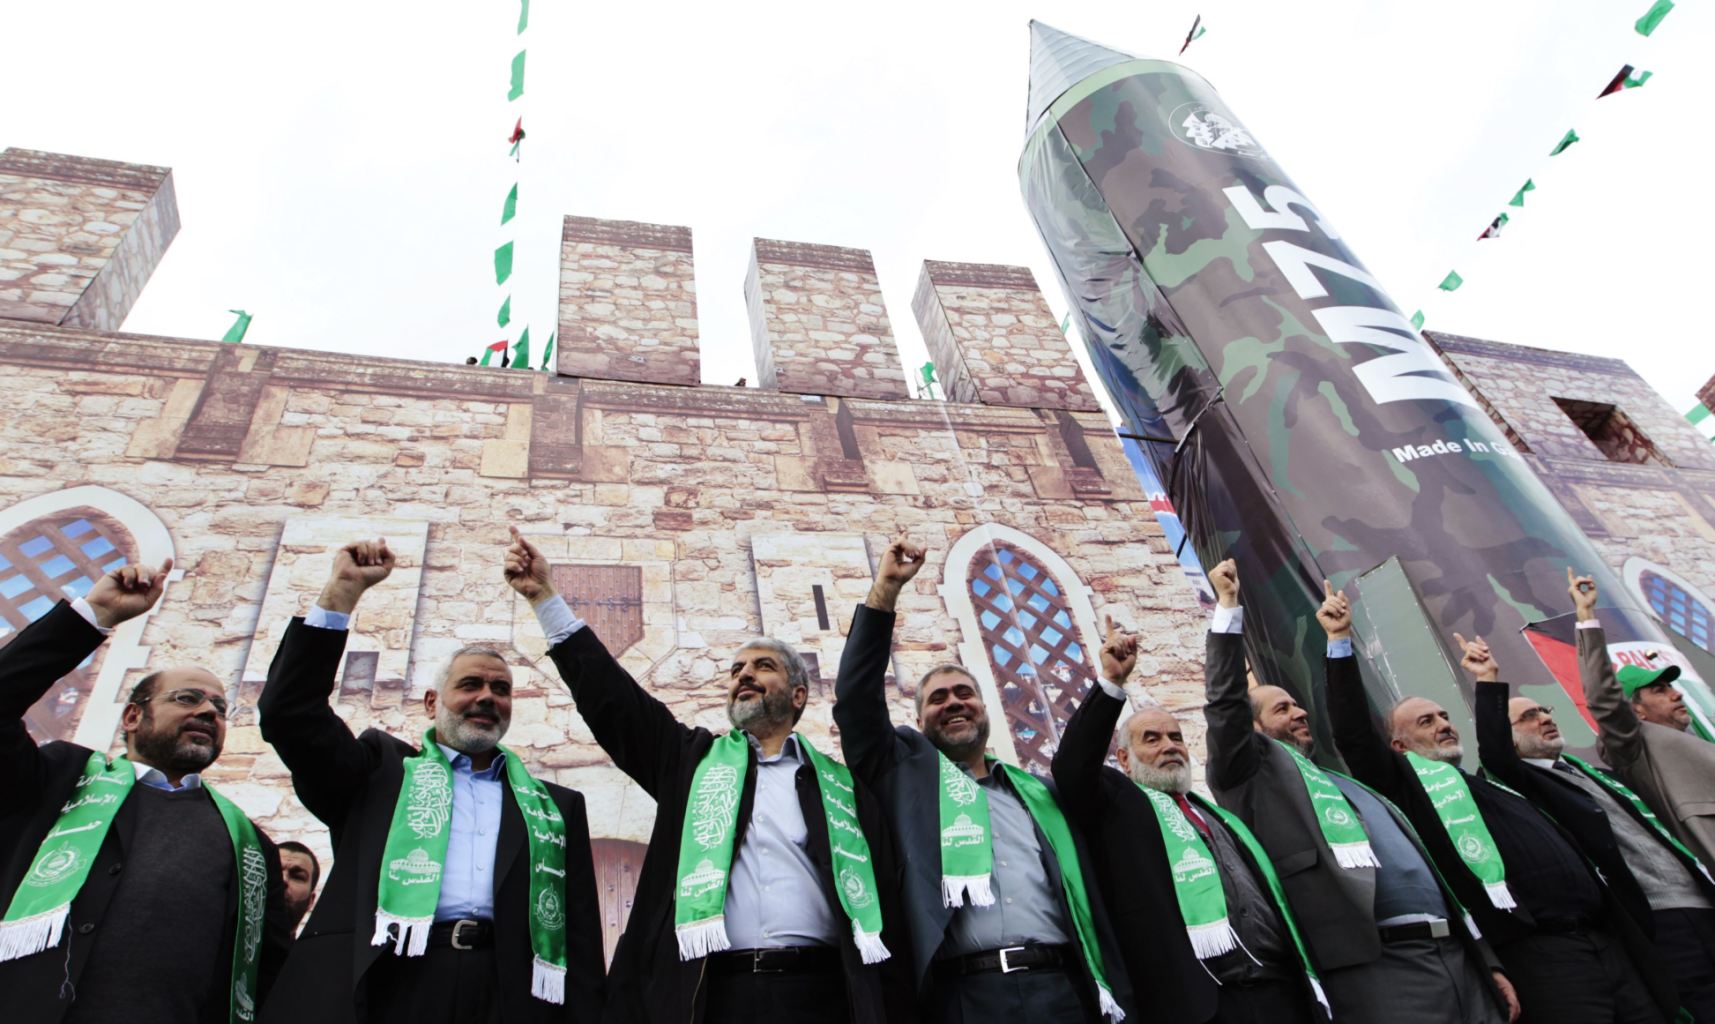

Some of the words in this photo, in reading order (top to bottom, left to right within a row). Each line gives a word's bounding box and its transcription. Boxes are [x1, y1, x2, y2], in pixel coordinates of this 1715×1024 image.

[1222, 185, 1479, 409] M75
[1392, 439, 1462, 463] Made
[1463, 438, 1490, 453] In
